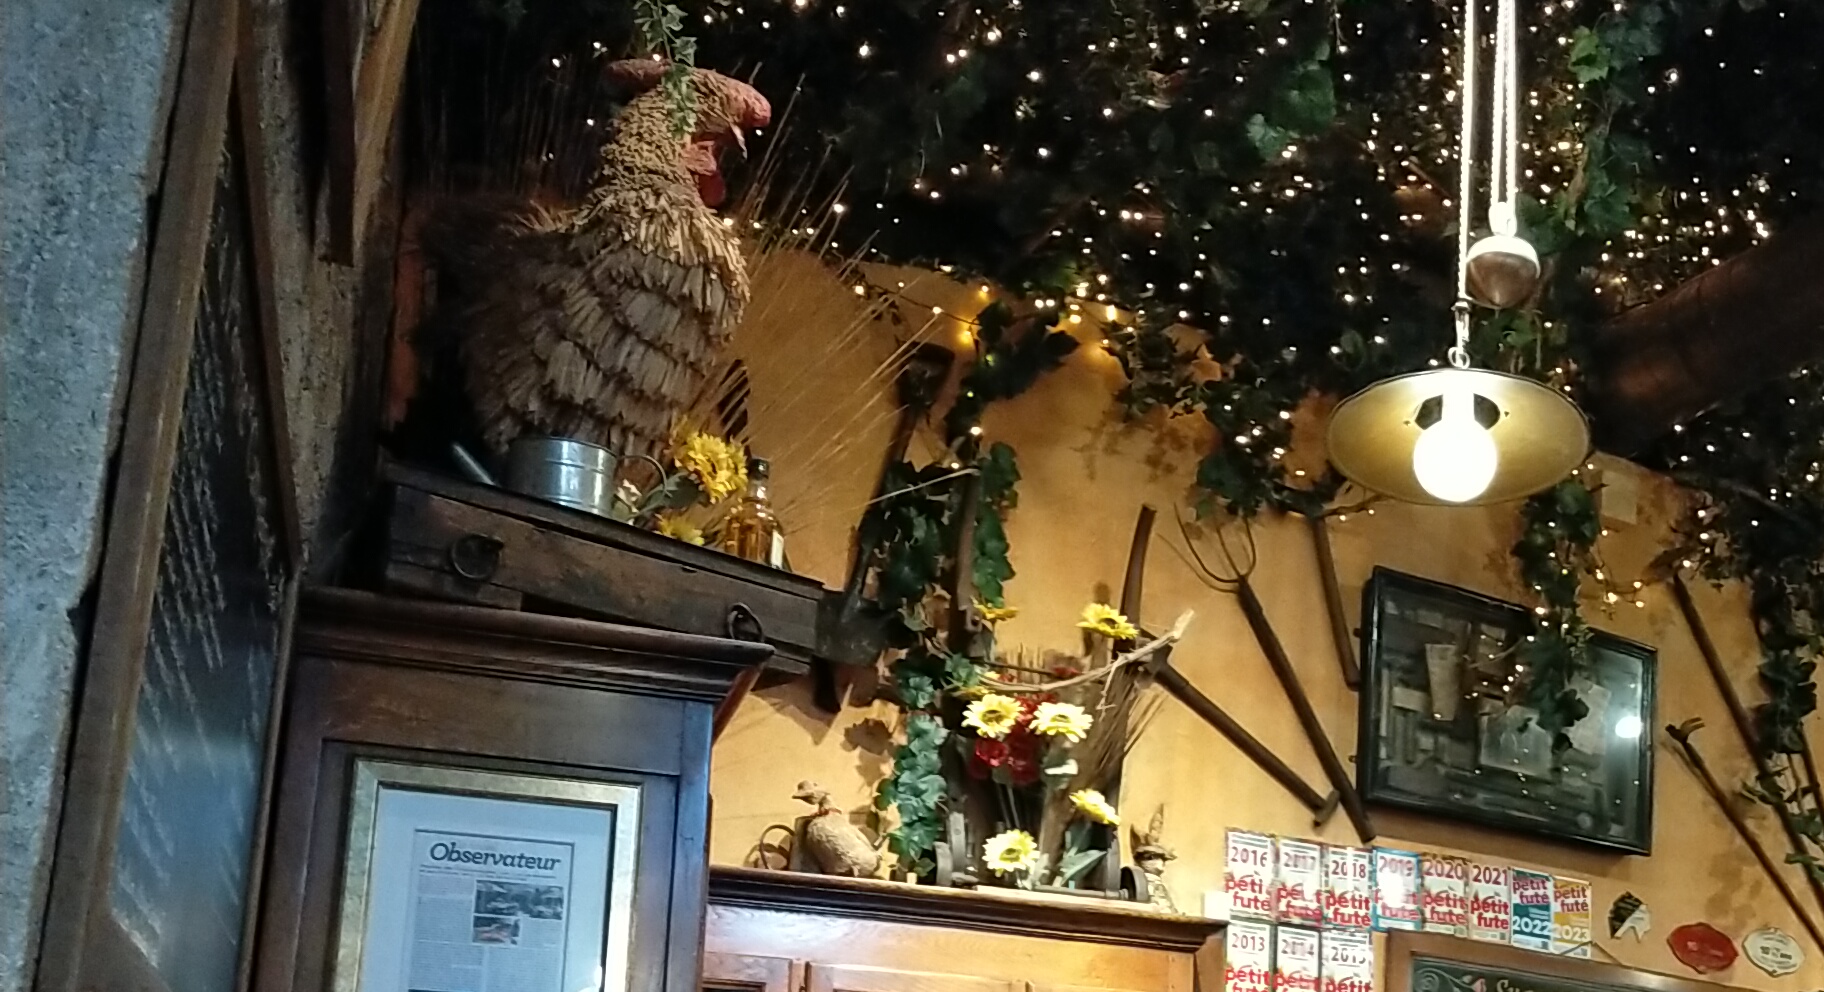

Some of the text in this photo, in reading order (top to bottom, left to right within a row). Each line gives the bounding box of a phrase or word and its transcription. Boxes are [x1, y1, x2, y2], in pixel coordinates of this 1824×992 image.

[430, 842, 562, 871] Observateur
[1230, 846, 1268, 868] 2016
[1331, 860, 1367, 879] 2018
[1424, 859, 1464, 880] 2020
[1472, 865, 1509, 886] 2021
[1512, 877, 1548, 894] petit
[1554, 885, 1588, 903] petit
[1325, 890, 1371, 911] petit
[1422, 891, 1467, 911] petit
[1470, 897, 1510, 916] petit
[1519, 891, 1550, 905] futé
[1560, 899, 1589, 913] futé
[1513, 916, 1552, 935] 2022
[1553, 924, 1590, 942] 2023
[1232, 933, 1265, 952] 2013
[1225, 968, 1271, 986] petit
